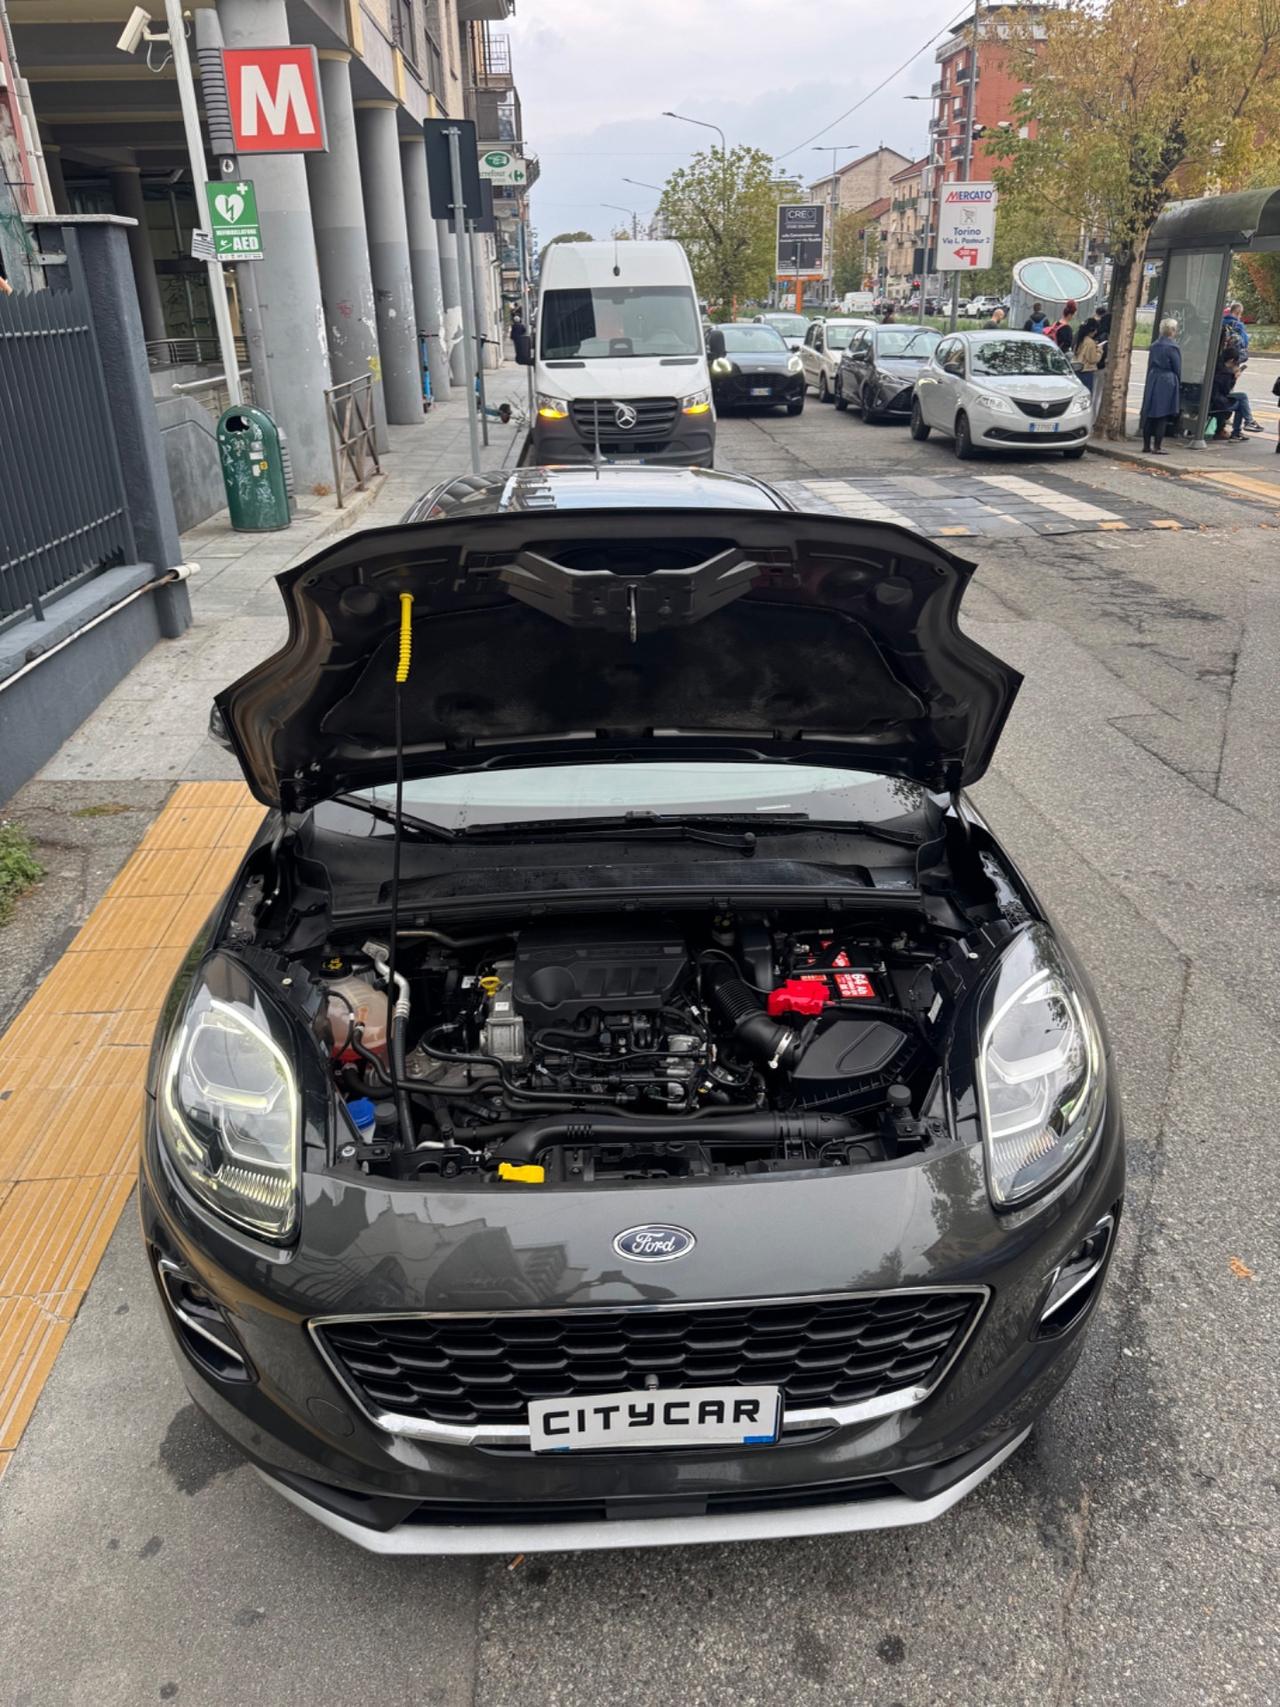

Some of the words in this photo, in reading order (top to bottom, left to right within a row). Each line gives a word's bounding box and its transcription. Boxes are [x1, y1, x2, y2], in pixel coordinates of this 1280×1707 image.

[240, 63, 315, 136] M
[945, 190, 992, 203] MERCATO
[953, 226, 981, 236] Torino
[233, 236, 259, 251] AED
[631, 1232, 675, 1253] Ford
[543, 1399, 760, 1436] CITYCAR
